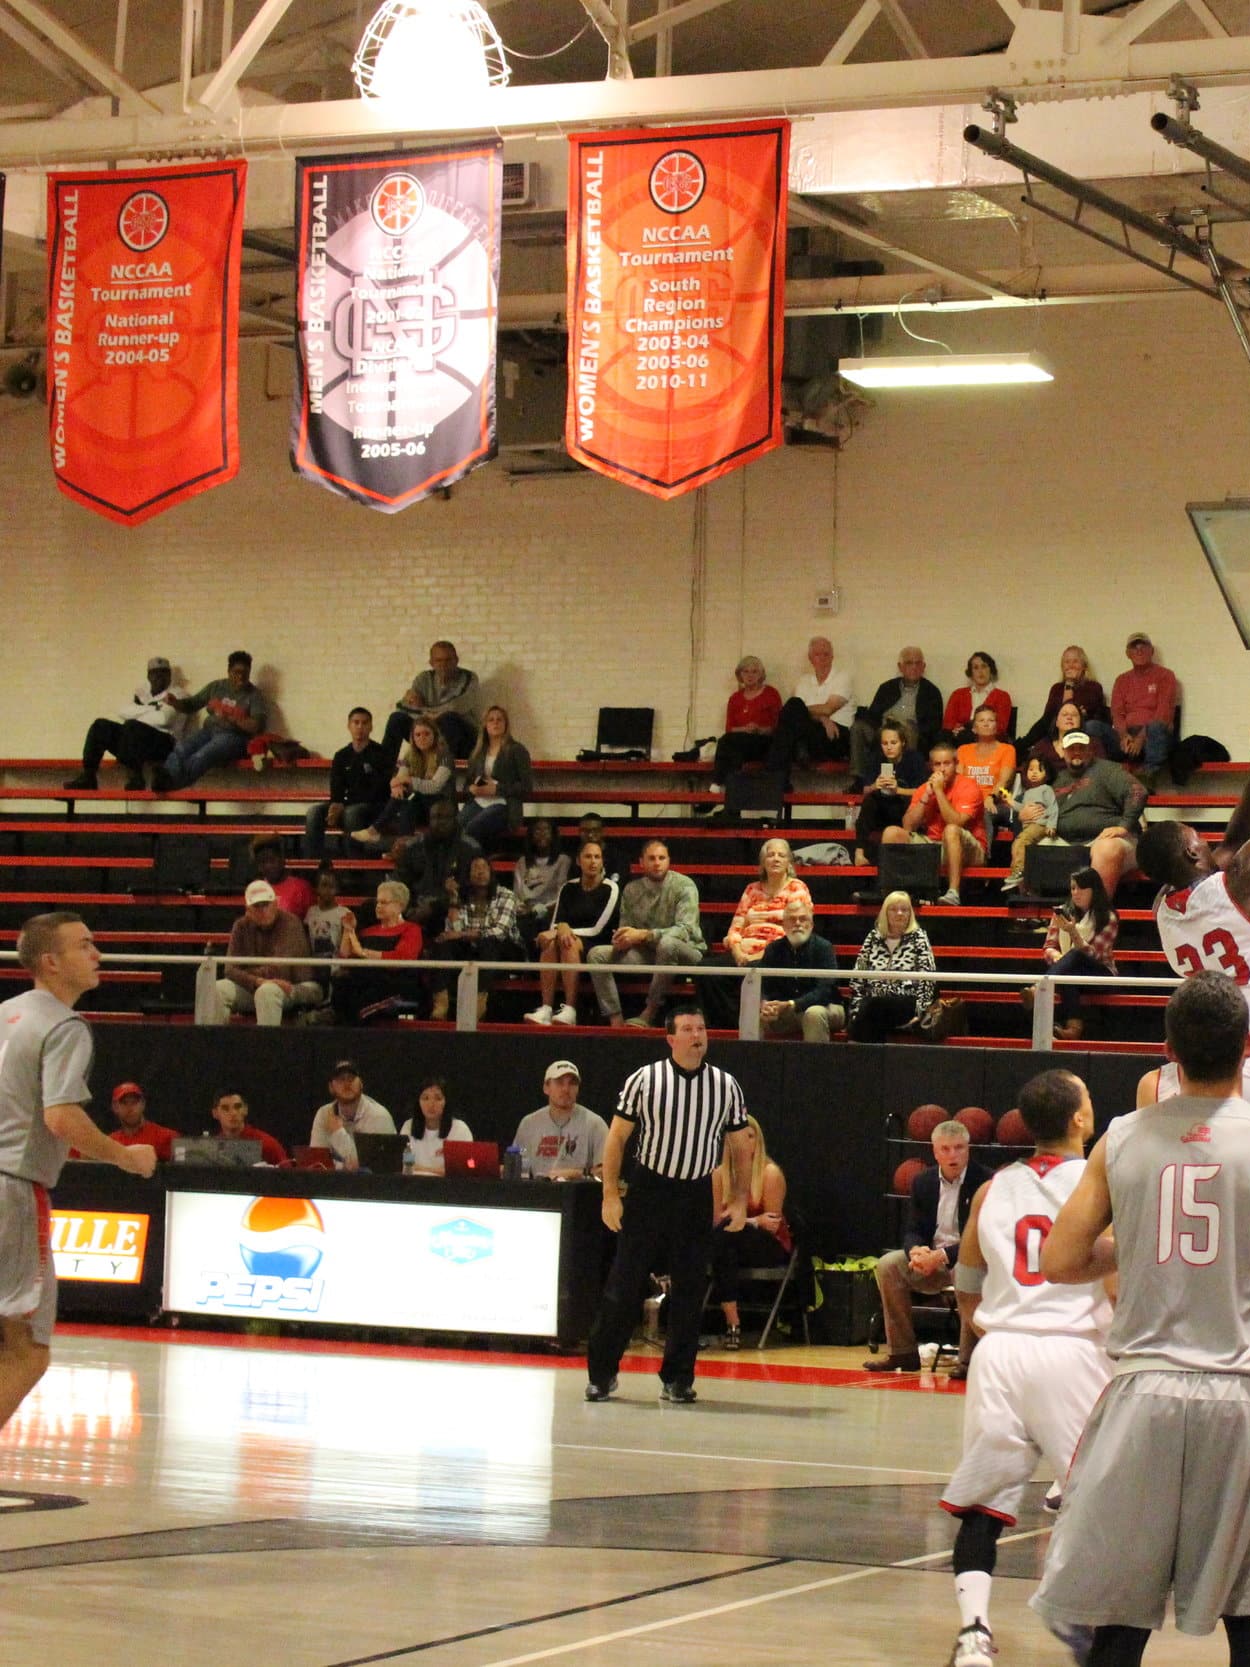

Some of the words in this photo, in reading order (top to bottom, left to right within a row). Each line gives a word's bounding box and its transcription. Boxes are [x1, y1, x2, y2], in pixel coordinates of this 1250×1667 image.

[584, 151, 603, 314] BASKETBALL
[641, 226, 710, 242] NCCAA
[309, 175, 328, 333] BASKETBALL
[368, 245, 427, 259] NCC
[619, 247, 734, 265] Tournament
[55, 189, 79, 345] BASKETBALL
[110, 262, 172, 280] NCCAA
[91, 284, 192, 302] Tournament
[650, 277, 700, 293] South
[644, 297, 705, 314] Region
[105, 312, 174, 328] National
[626, 317, 724, 335] Champions
[98, 330, 180, 348] Runner-up
[637, 336, 709, 351] 2003-04
[104, 348, 170, 365] 2004-05
[636, 355, 709, 371] 2005-06
[311, 339, 324, 414] MEN'S
[579, 321, 600, 441] WOMEN'S
[636, 374, 708, 390] 2010-11
[53, 350, 70, 468] WOMEN'S
[361, 442, 426, 458] 2005-06
[1157, 1163, 1222, 1266] 15
[49, 1216, 141, 1256] ILLE
[1013, 1214, 1053, 1287] 0
[196, 1270, 325, 1313] PEPSI
